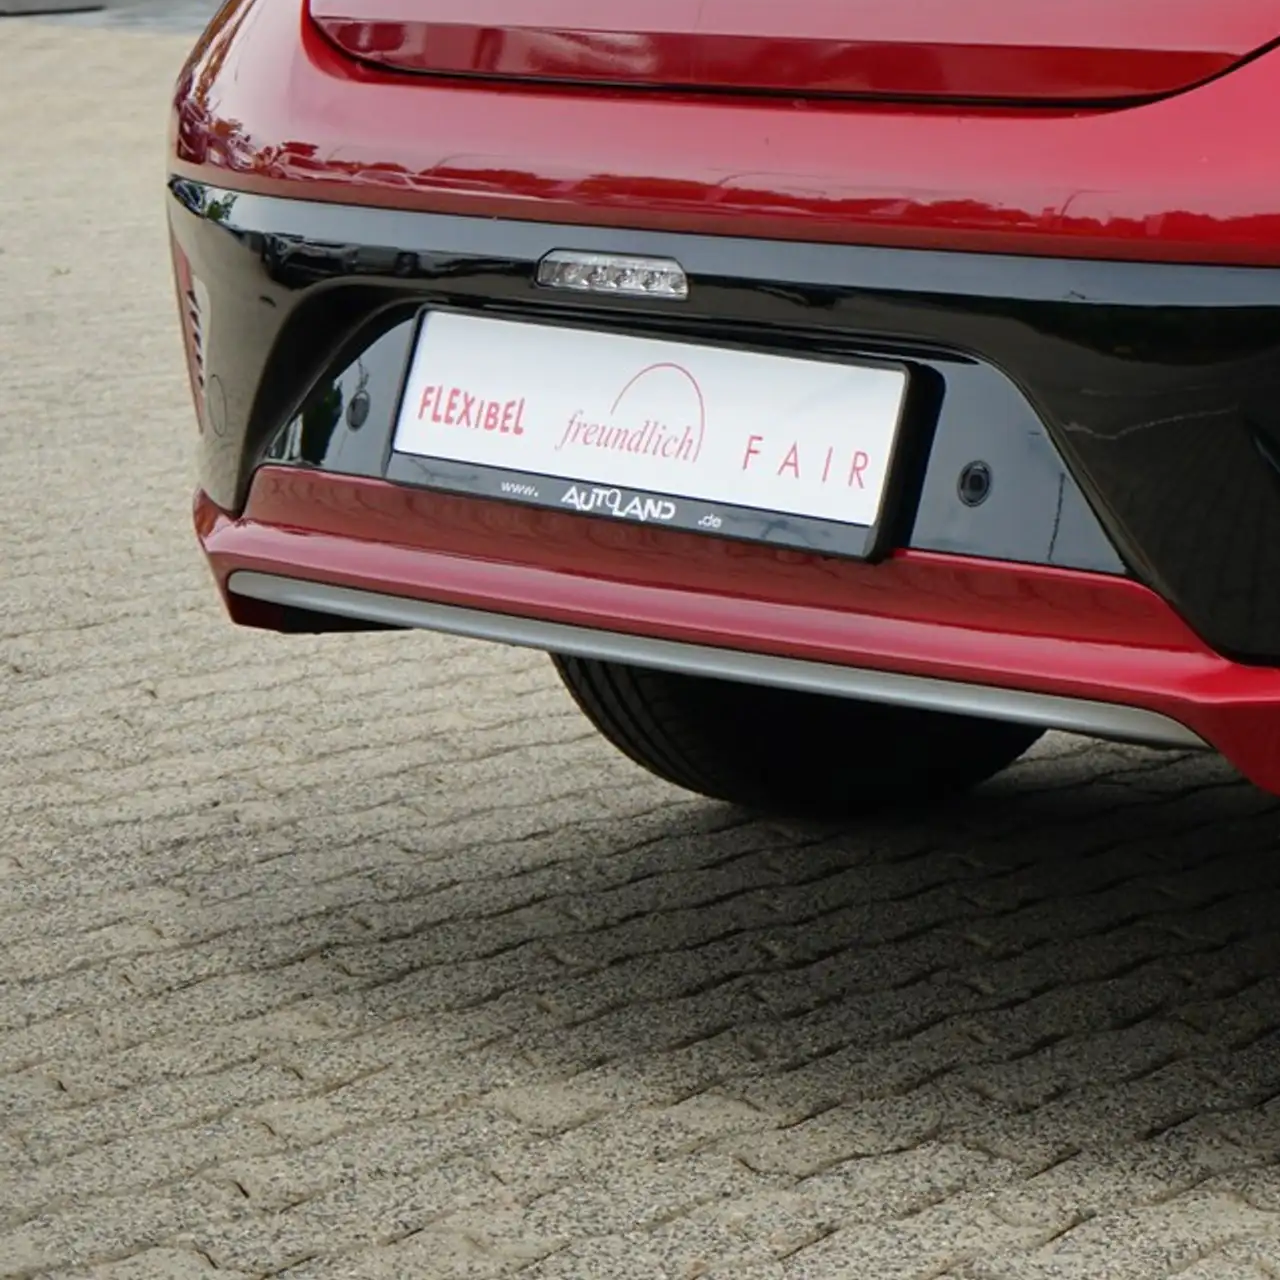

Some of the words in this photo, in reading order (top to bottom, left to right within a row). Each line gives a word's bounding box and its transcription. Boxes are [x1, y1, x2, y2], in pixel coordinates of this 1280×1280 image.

[418, 384, 526, 436] FLEXIBEL
[554, 408, 696, 462] freundlich
[742, 434, 870, 490] FAIR
[561, 485, 676, 521] AUTOLAND
